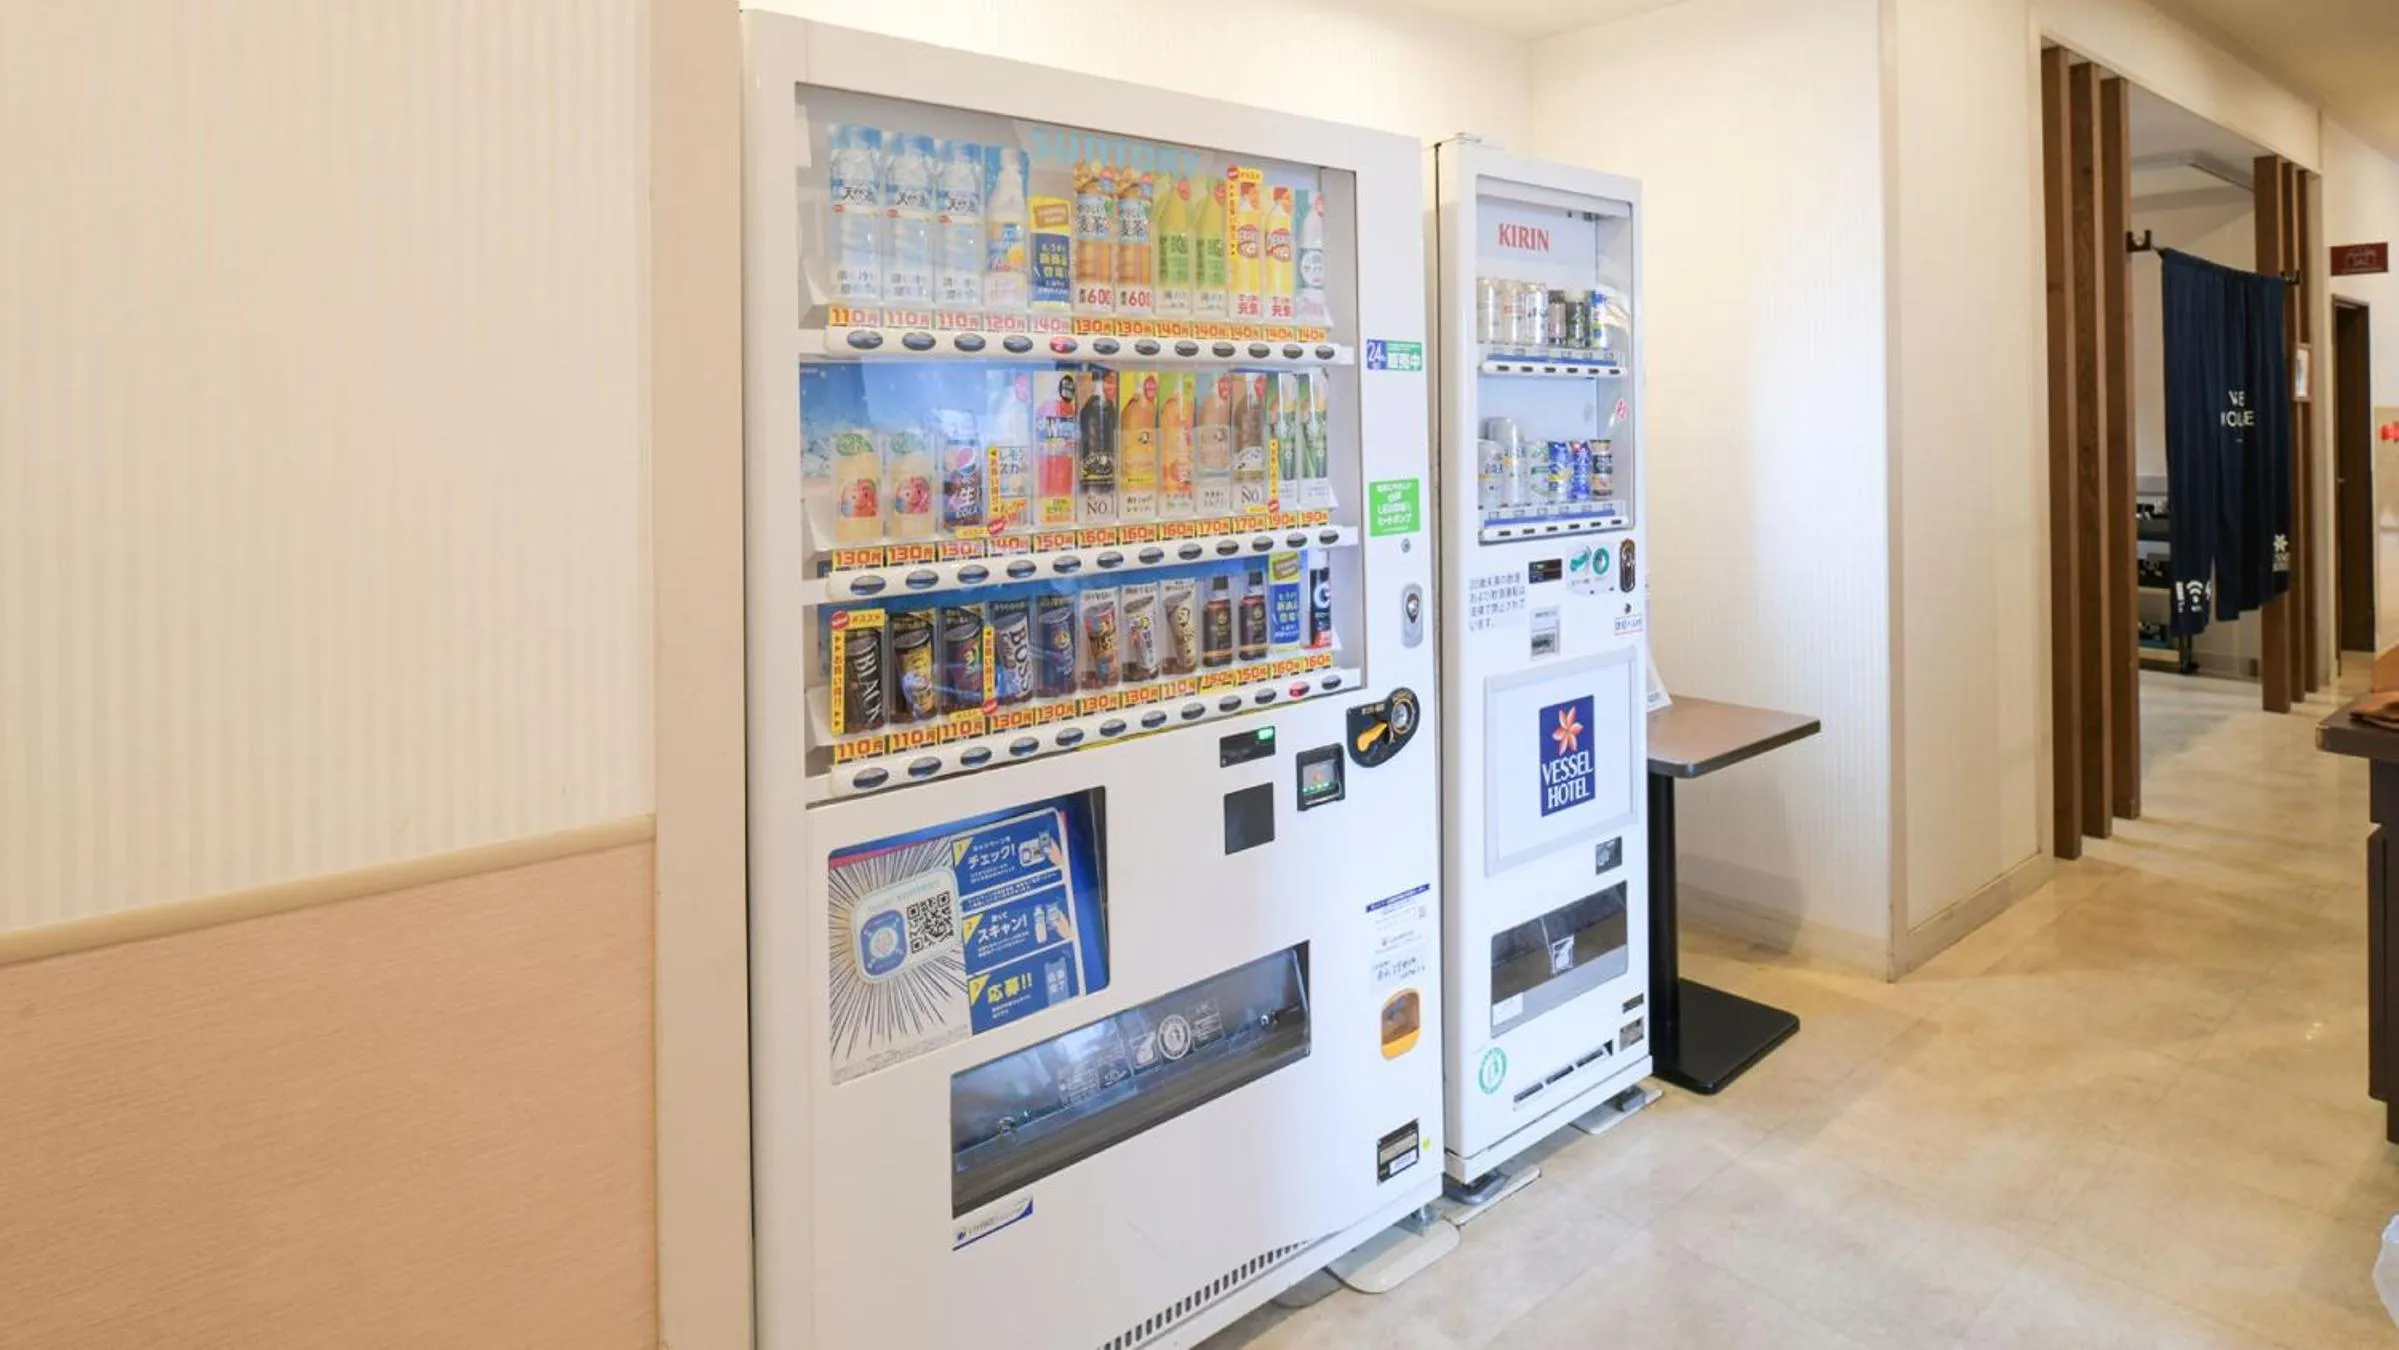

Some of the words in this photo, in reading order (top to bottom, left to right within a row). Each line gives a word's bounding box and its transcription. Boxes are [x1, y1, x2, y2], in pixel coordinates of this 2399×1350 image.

[1498, 223, 1550, 251] KIRIN
[1009, 624, 1030, 692] BOSS
[1541, 751, 1594, 786] VESSEL
[1547, 776, 1590, 809] HOTEL
[968, 843, 1015, 869] チェック!
[977, 913, 1027, 942] スキャン!
